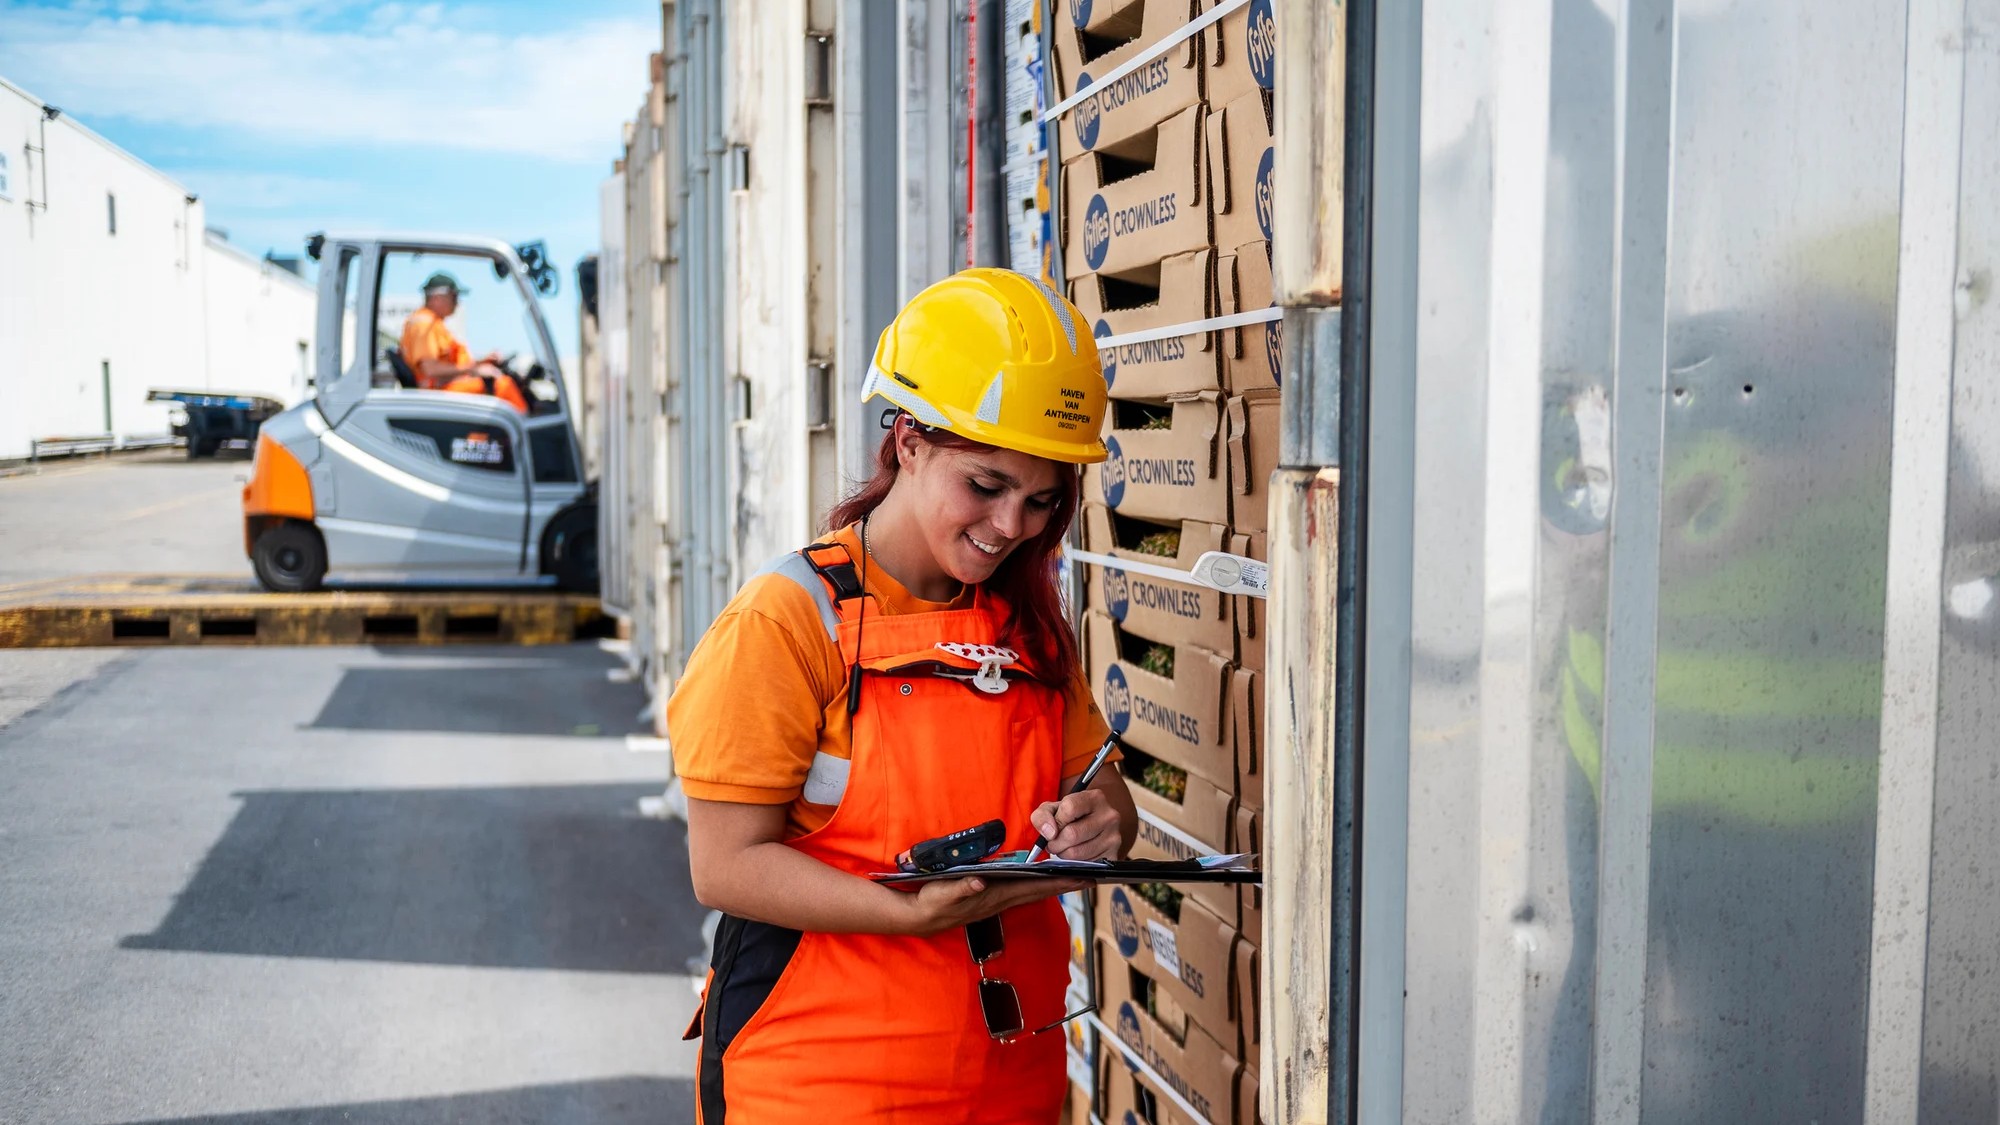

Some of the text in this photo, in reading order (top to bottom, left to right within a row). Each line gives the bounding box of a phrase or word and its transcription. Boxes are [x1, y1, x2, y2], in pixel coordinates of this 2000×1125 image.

[1249, 9, 1276, 79] fyffe
[1102, 56, 1168, 112] CROWNLESS
[1084, 209, 1109, 261] fyffes
[1113, 193, 1176, 237] CROWNLESS
[1120, 336, 1184, 365] CROWNLESS
[1060, 388, 1085, 400] HAVEN
[1064, 400, 1080, 410] VAN
[1044, 409, 1091, 424] ANTWERPEN
[1128, 459, 1195, 487] CROWNLESS
[1131, 581, 1201, 620] CROWNLESS
[1133, 695, 1200, 746] CROWNLESS
